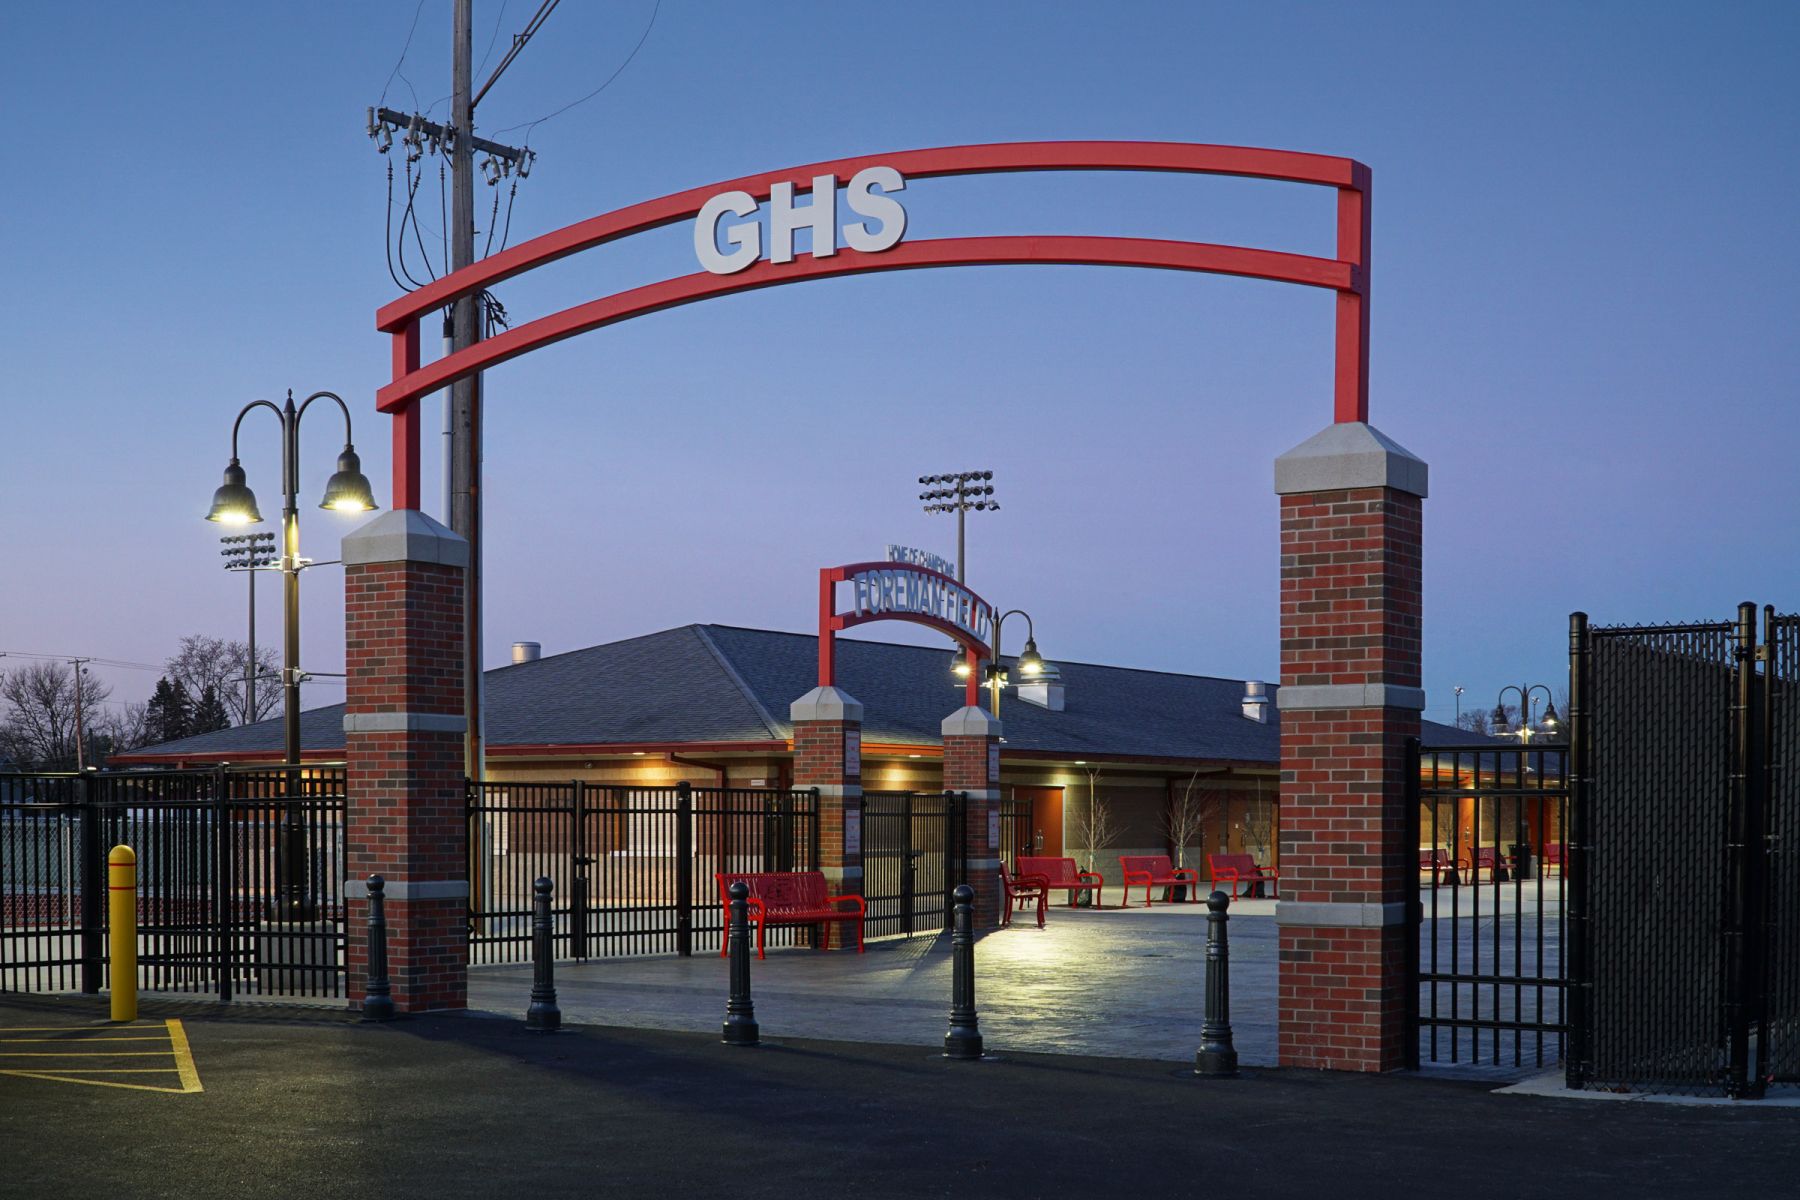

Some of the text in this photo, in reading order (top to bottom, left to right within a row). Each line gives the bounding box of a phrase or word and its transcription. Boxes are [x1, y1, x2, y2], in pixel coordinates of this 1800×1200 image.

[694, 166, 907, 275] GHS
[887, 544, 908, 562] HOME
[909, 547, 918, 565] OF
[853, 569, 988, 641] FOREMAN FIELD
